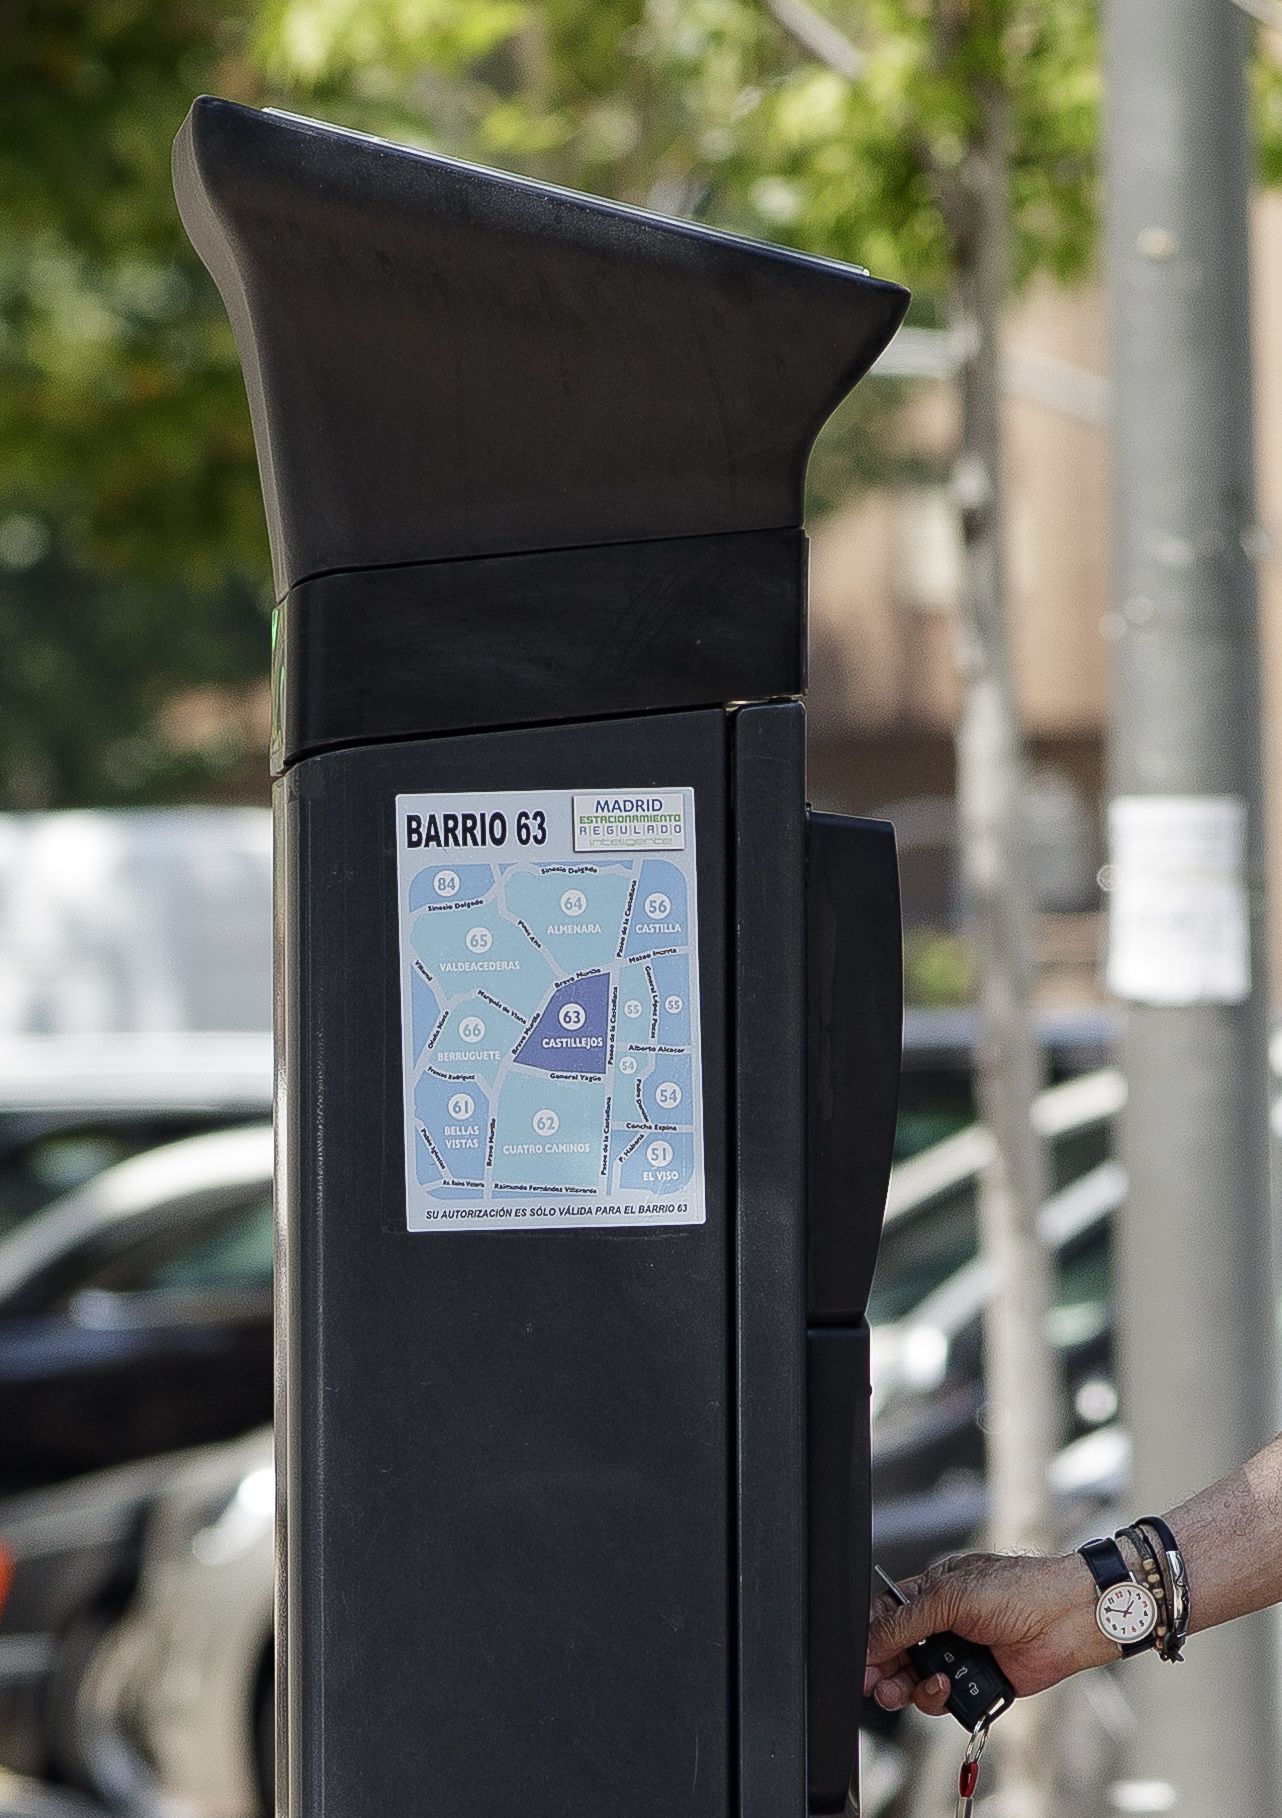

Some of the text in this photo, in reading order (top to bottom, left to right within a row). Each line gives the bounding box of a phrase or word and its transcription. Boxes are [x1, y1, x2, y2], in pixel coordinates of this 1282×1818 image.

[595, 799, 663, 813] MADRID
[580, 814, 681, 824] ESTACIONAMIENTO
[406, 810, 547, 848] BARRIO 63
[438, 878, 455, 890] 84
[564, 897, 582, 910] 64
[649, 901, 667, 913] 56
[548, 924, 601, 934] ALMENARA
[636, 924, 681, 933] CASTILLA
[470, 934, 487, 947] 65
[440, 961, 520, 972] VALDEACEDERAS
[627, 1005, 639, 1014] 55
[668, 1000, 680, 1010] 55
[563, 1011, 581, 1024] 63
[463, 1024, 481, 1037] 66
[543, 1037, 603, 1049] CASTILLEJOS
[438, 1051, 500, 1061] BERRUGUETE
[660, 1089, 677, 1102] 54
[453, 1100, 469, 1113] 61
[537, 1117, 555, 1130] 62
[445, 1126, 479, 1135] BELLAS
[445, 1139, 479, 1148] VISTAS
[503, 1143, 590, 1154] CUATRO CAMINOS
[651, 1148, 666, 1161] 51
[643, 1171, 679, 1180] EL VISO
[426, 1204, 688, 1219] SU AUTORIZACIÓN ES SÓLO VÁLIDA PARA EL BARRIO 63
